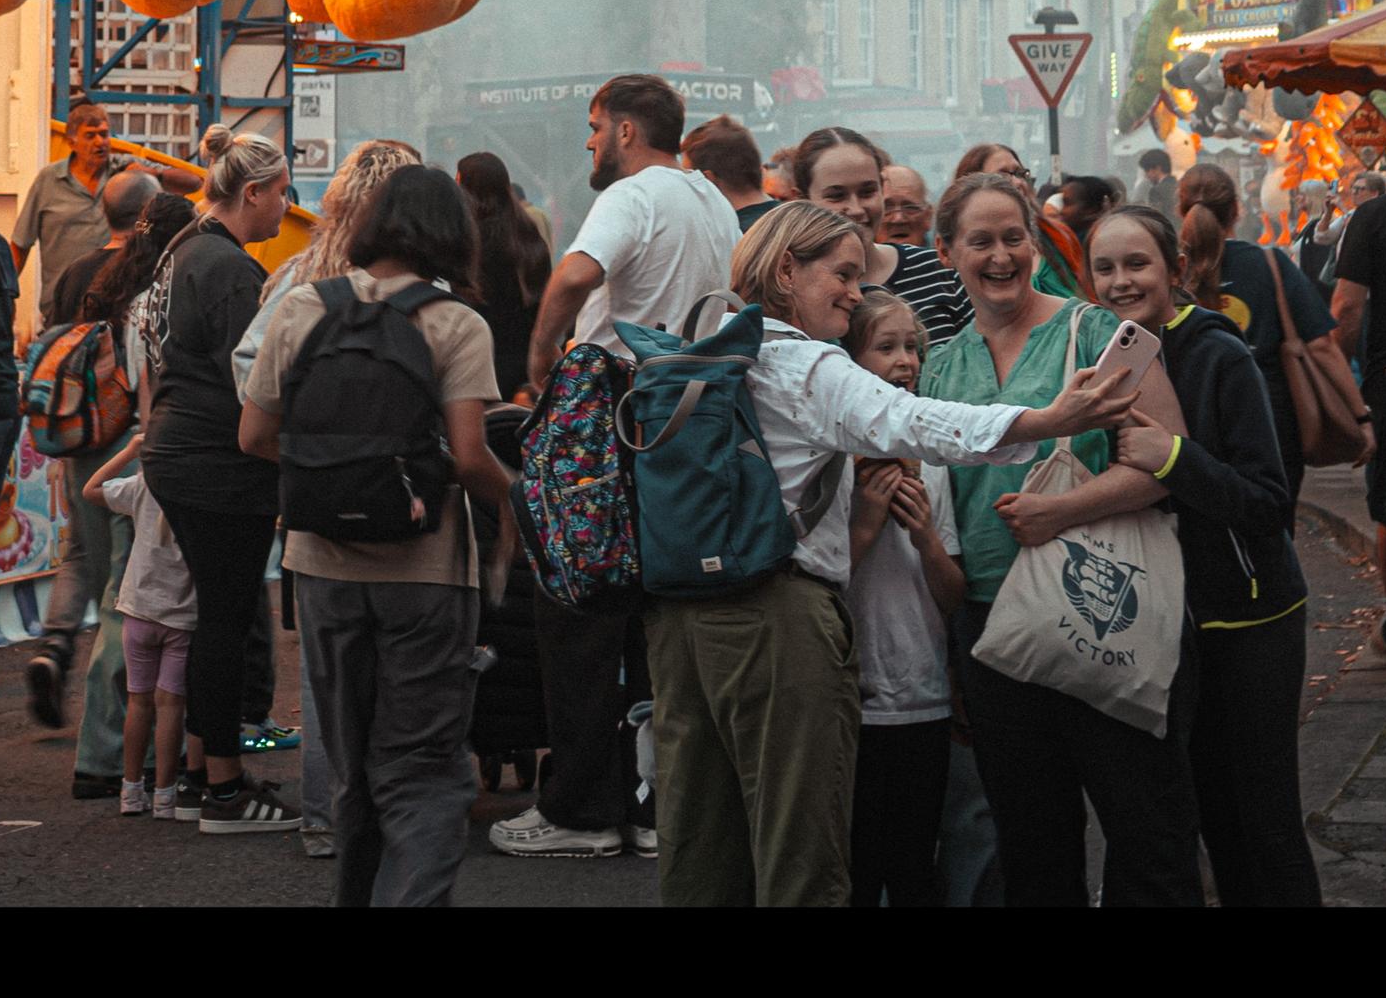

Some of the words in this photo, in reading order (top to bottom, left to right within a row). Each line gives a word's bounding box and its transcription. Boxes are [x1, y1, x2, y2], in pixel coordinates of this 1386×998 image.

[1026, 44, 1072, 59] GIVE
[1037, 63, 1066, 73] WAY
[301, 81, 332, 91] parks
[479, 86, 548, 104] INSTITUTE
[551, 86, 570, 101] OF
[668, 81, 743, 101] ACTOR
[1080, 531, 1115, 554] HMS
[1058, 615, 1136, 667] VICTORY
